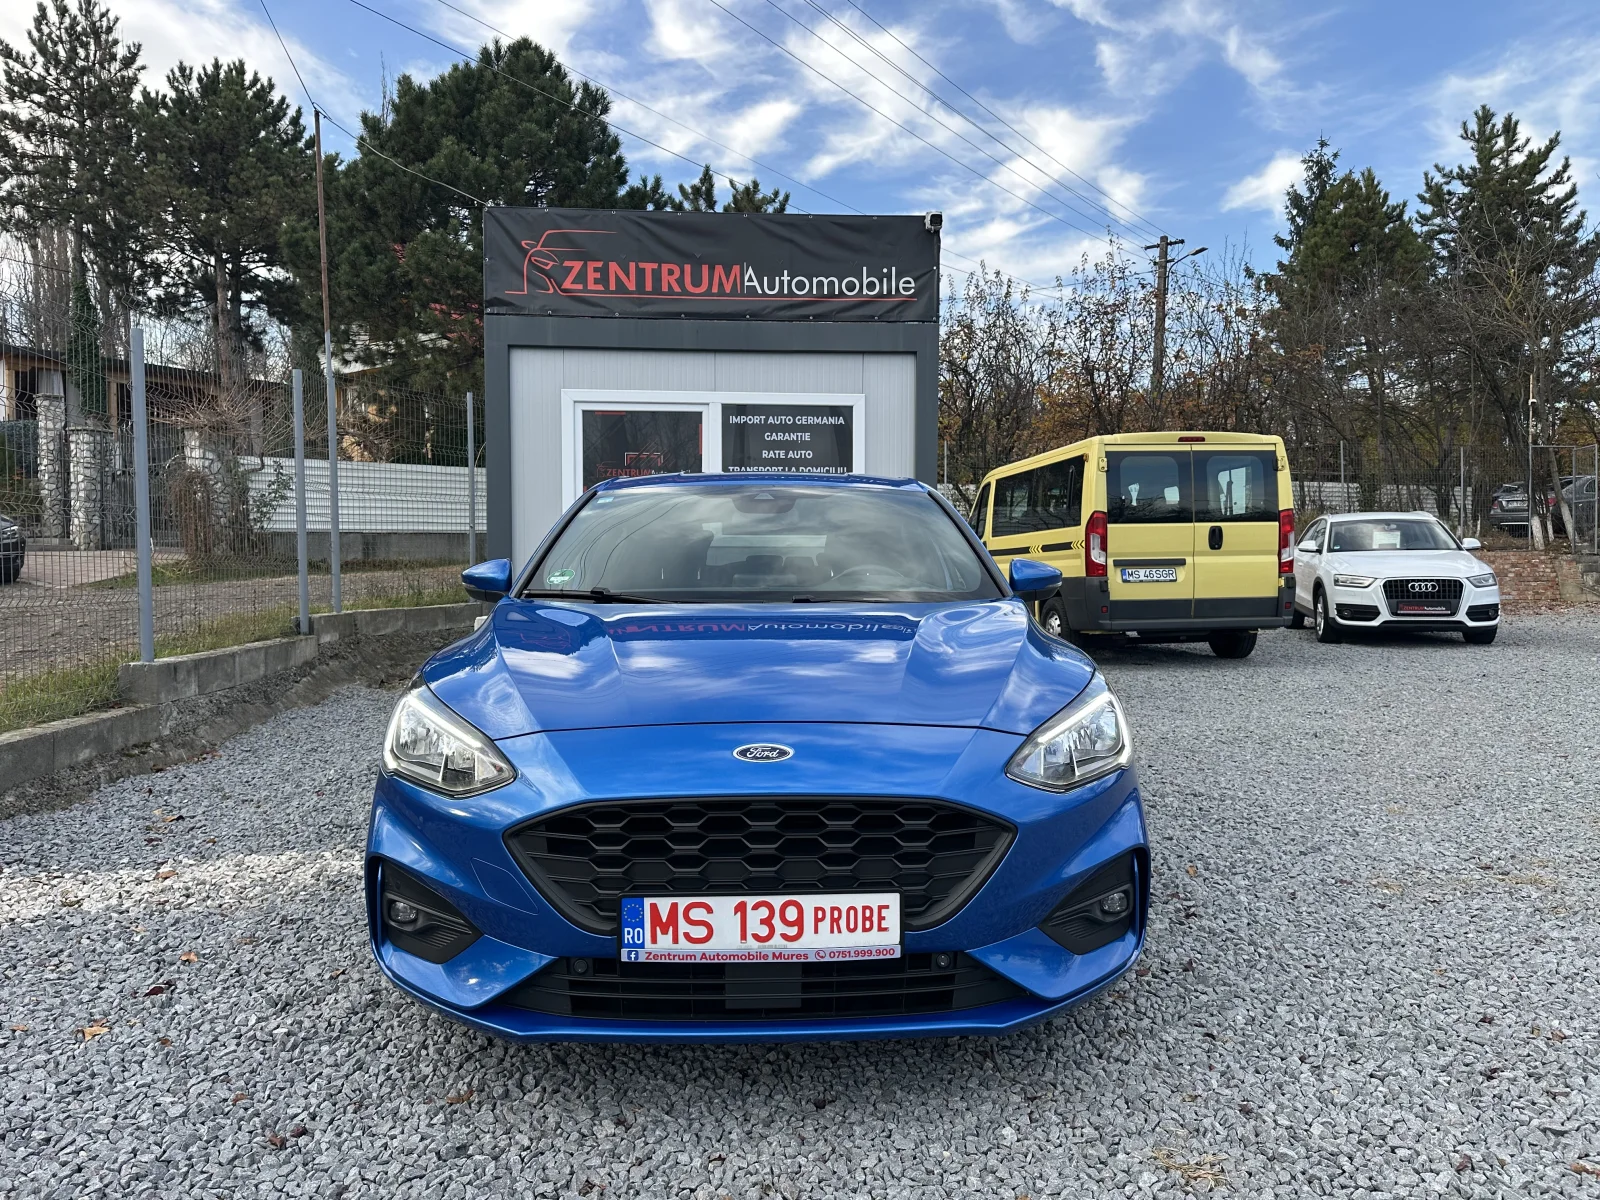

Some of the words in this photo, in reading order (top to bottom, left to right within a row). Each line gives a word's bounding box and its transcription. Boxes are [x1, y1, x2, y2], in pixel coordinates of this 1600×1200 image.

[561, 261, 741, 294] ZENTRUM
[744, 265, 916, 296] Automobile
[729, 415, 766, 424] IMPORT
[767, 416, 794, 425] AUTO
[795, 416, 845, 425] GERMANIA
[764, 432, 811, 444] GARANȚIE
[762, 450, 785, 459] RATE
[787, 450, 813, 459] AUTO
[606, 468, 651, 477] ZENTRUM
[1127, 570, 1140, 579] MS
[746, 747, 780, 758] Ford
[624, 927, 643, 944] RO
[650, 901, 714, 945] MS
[733, 899, 804, 944] 139
[813, 904, 890, 934] PROBE
[645, 951, 697, 961] Zentrum
[699, 951, 770, 961] Automobile
[772, 951, 809, 961] Mures
[829, 947, 896, 959] 0751.999.900
